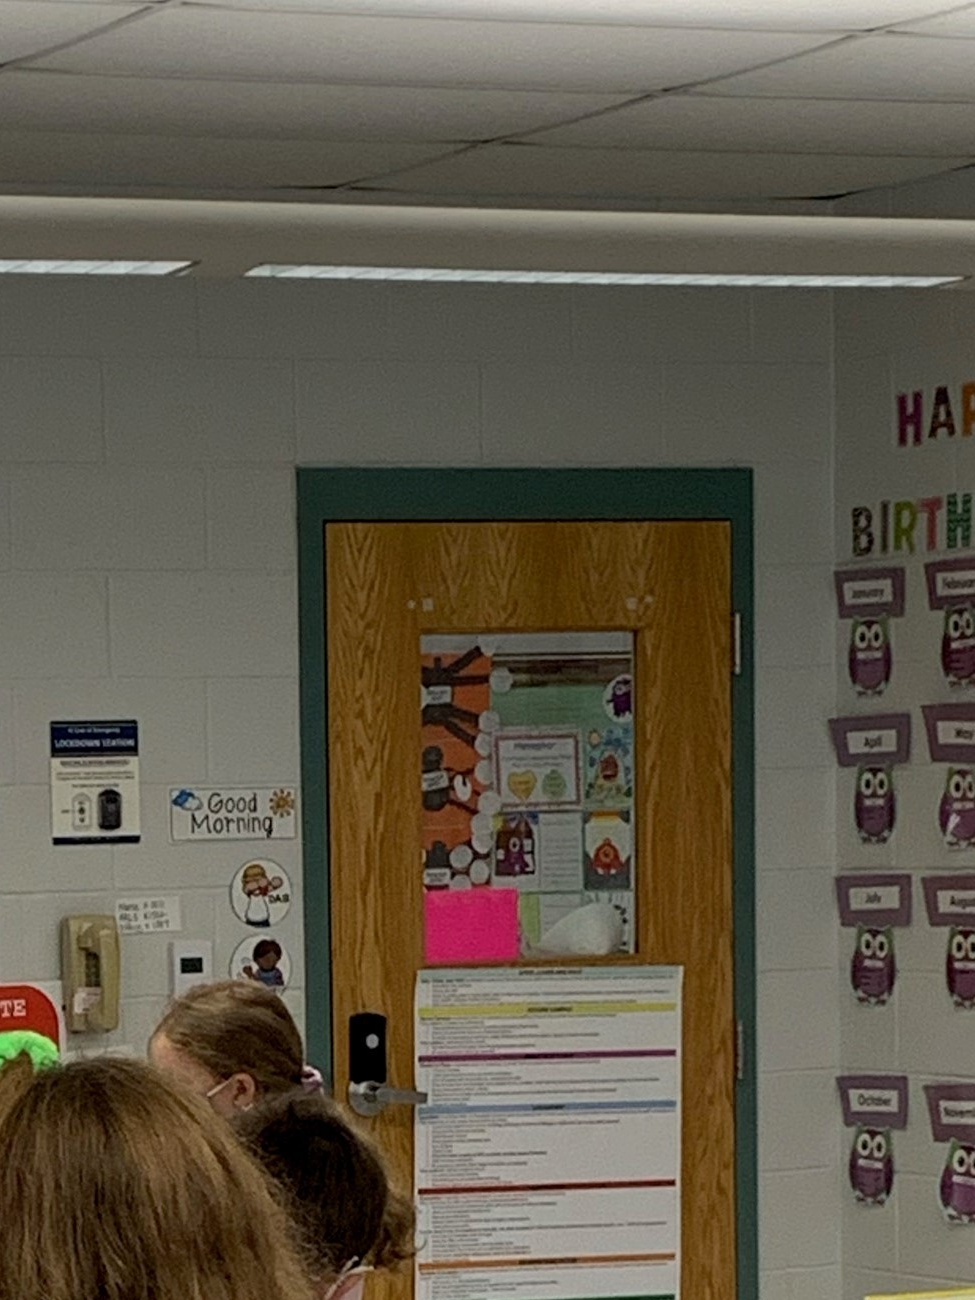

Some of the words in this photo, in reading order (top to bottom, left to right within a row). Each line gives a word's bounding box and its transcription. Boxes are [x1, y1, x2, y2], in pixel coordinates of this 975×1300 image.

[852, 493, 973, 557] BIRTH
[864, 736, 882, 749] April
[207, 792, 258, 814] Good
[190, 813, 274, 838] Morning
[857, 1093, 892, 1107] October
